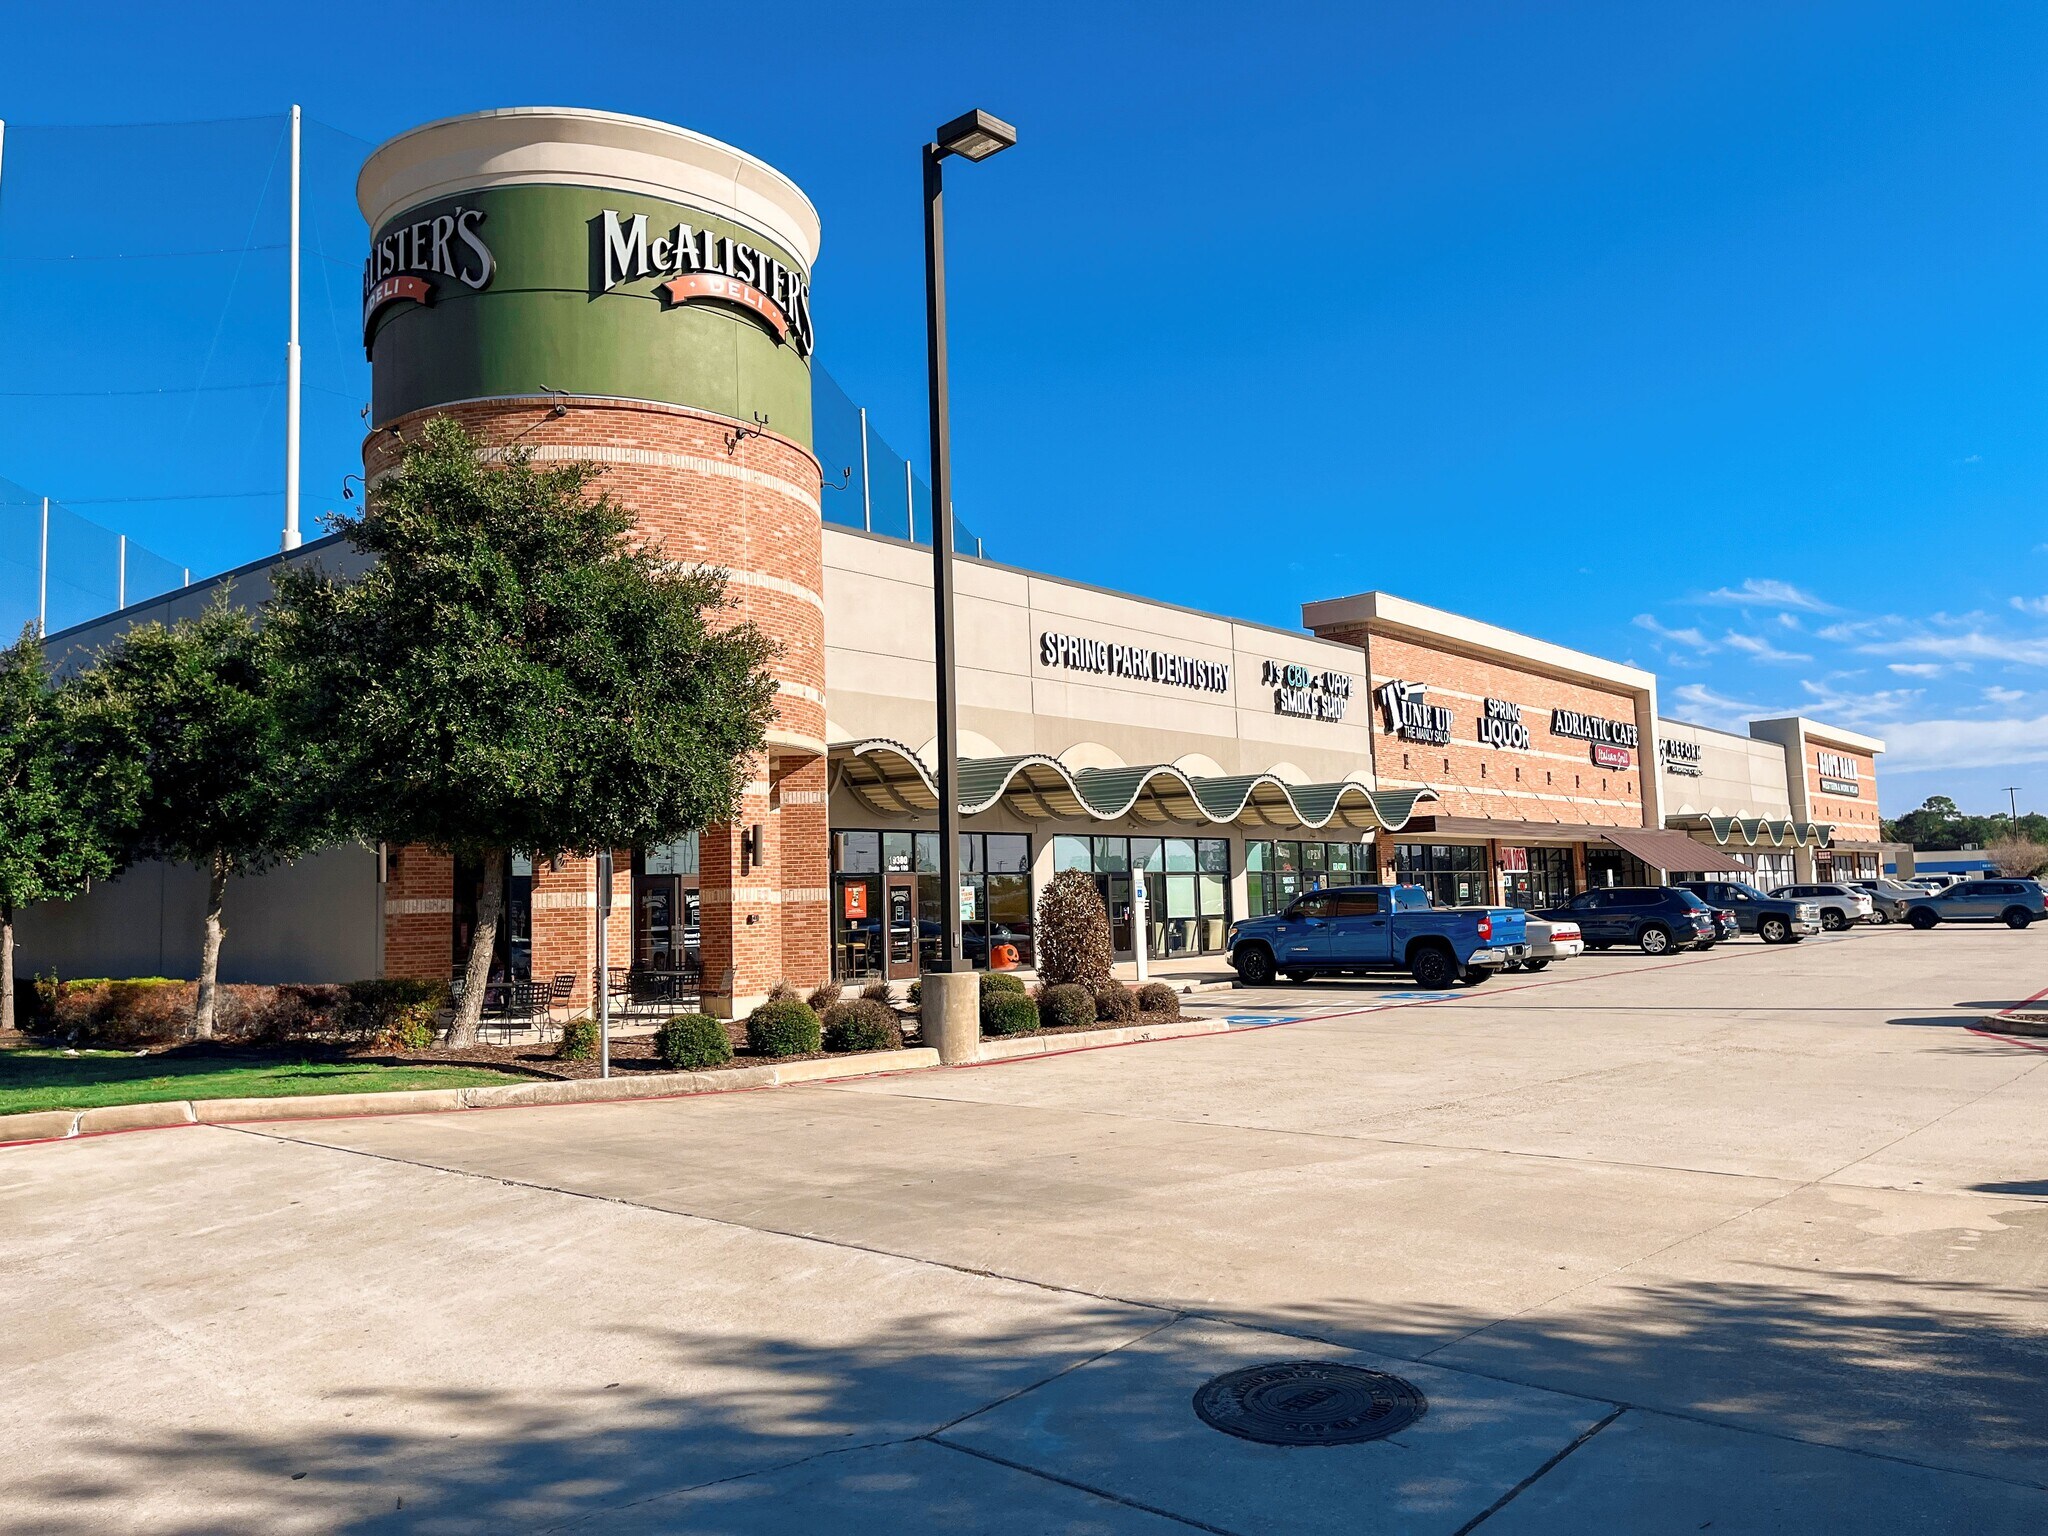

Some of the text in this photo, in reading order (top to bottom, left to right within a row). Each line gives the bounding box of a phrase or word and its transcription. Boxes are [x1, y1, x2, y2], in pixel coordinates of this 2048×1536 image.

[369, 279, 399, 311] DELI
[705, 279, 763, 310] DELI
[1044, 631, 1230, 691] SPRING PARK DENTISTRY
[1287, 664, 1310, 688] CBD
[1326, 671, 1353, 697] VAPE
[1281, 688, 1347, 719] SMOKE SHOP
[1488, 698, 1521, 722] SPRING
[1435, 707, 1453, 732] UP
[1481, 717, 1530, 748] LIQUOR
[1555, 710, 1638, 747] ADRIATIC CAFE
